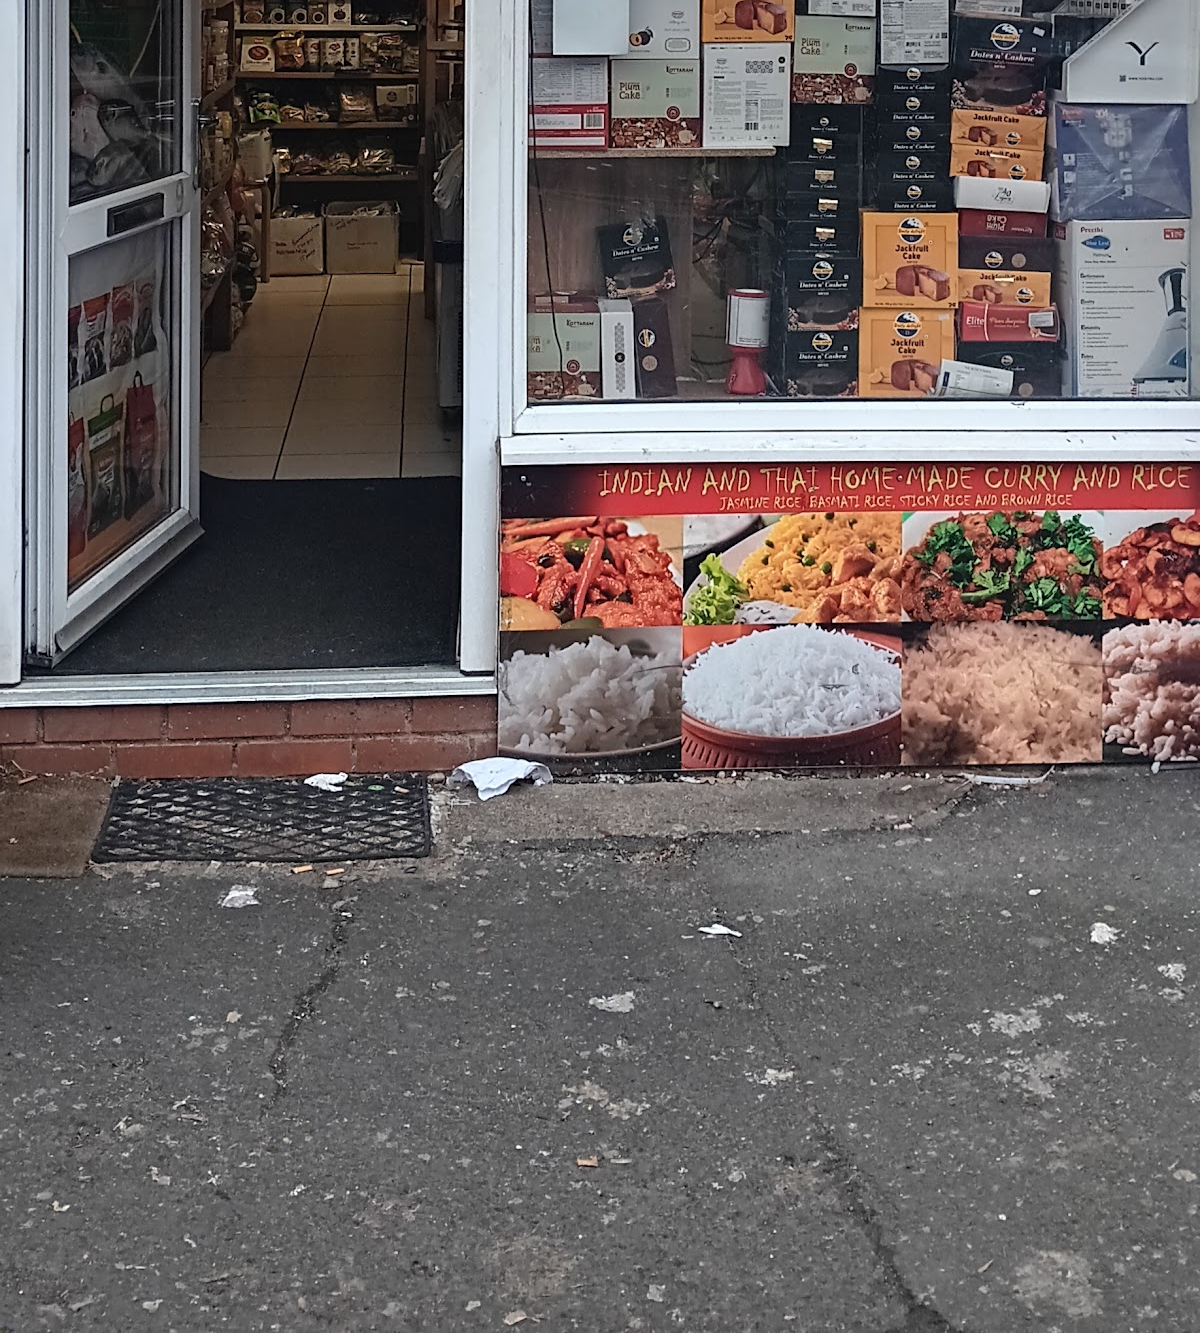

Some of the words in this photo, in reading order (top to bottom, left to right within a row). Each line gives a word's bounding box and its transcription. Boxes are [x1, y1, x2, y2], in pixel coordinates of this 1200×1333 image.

[801, 38, 820, 47] Plum
[801, 47, 821, 55] Cake
[970, 49, 993, 59] Dates
[1004, 53, 1035, 62] Cashew
[619, 82, 640, 91] Plum
[619, 91, 641, 100] Cake
[973, 113, 1002, 122] Jackfruit
[966, 316, 985, 325] Elite
[598, 467, 692, 497] INDIAN
[701, 466, 750, 496] AND
[759, 466, 820, 494] THAI
[984, 464, 1064, 491] CURRY
[1072, 464, 1120, 491] AND
[1131, 464, 1193, 491] RICE
[718, 496, 771, 511] JASMINE
[809, 495, 860, 509] BASMATI
[864, 495, 896, 509] RICE,
[899, 493, 941, 508] STICKY
[942, 494, 972, 507] RICE
[974, 494, 997, 507] AND
[1001, 493, 1042, 506] BROWN
[1044, 493, 1073, 506] RICE
